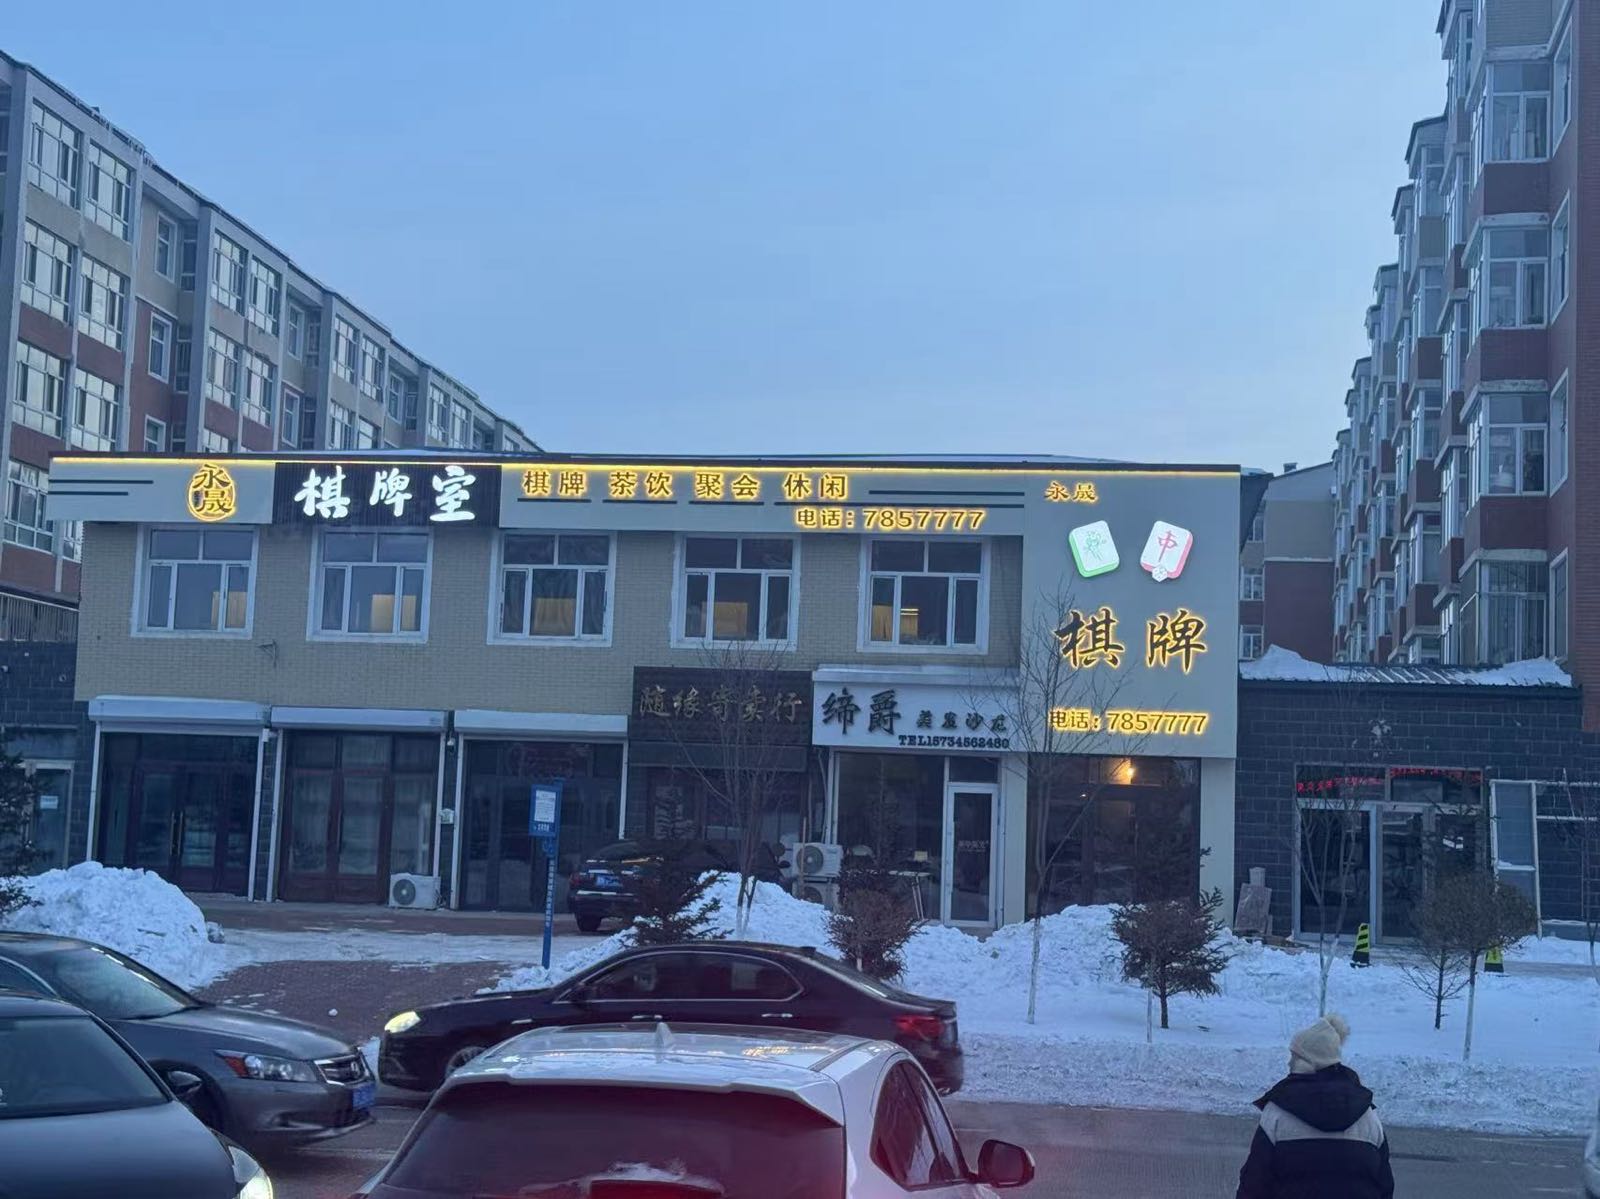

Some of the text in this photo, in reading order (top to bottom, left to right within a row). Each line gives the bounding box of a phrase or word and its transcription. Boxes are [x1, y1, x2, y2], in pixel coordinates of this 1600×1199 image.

[294, 465, 477, 522] 棋牌室
[523, 471, 846, 498] 棋牌 茶饮 聚会 休闲
[1044, 482, 1097, 500] 永晟
[1053, 608, 1207, 673] 棋牌
[821, 687, 901, 735] 缔爵
